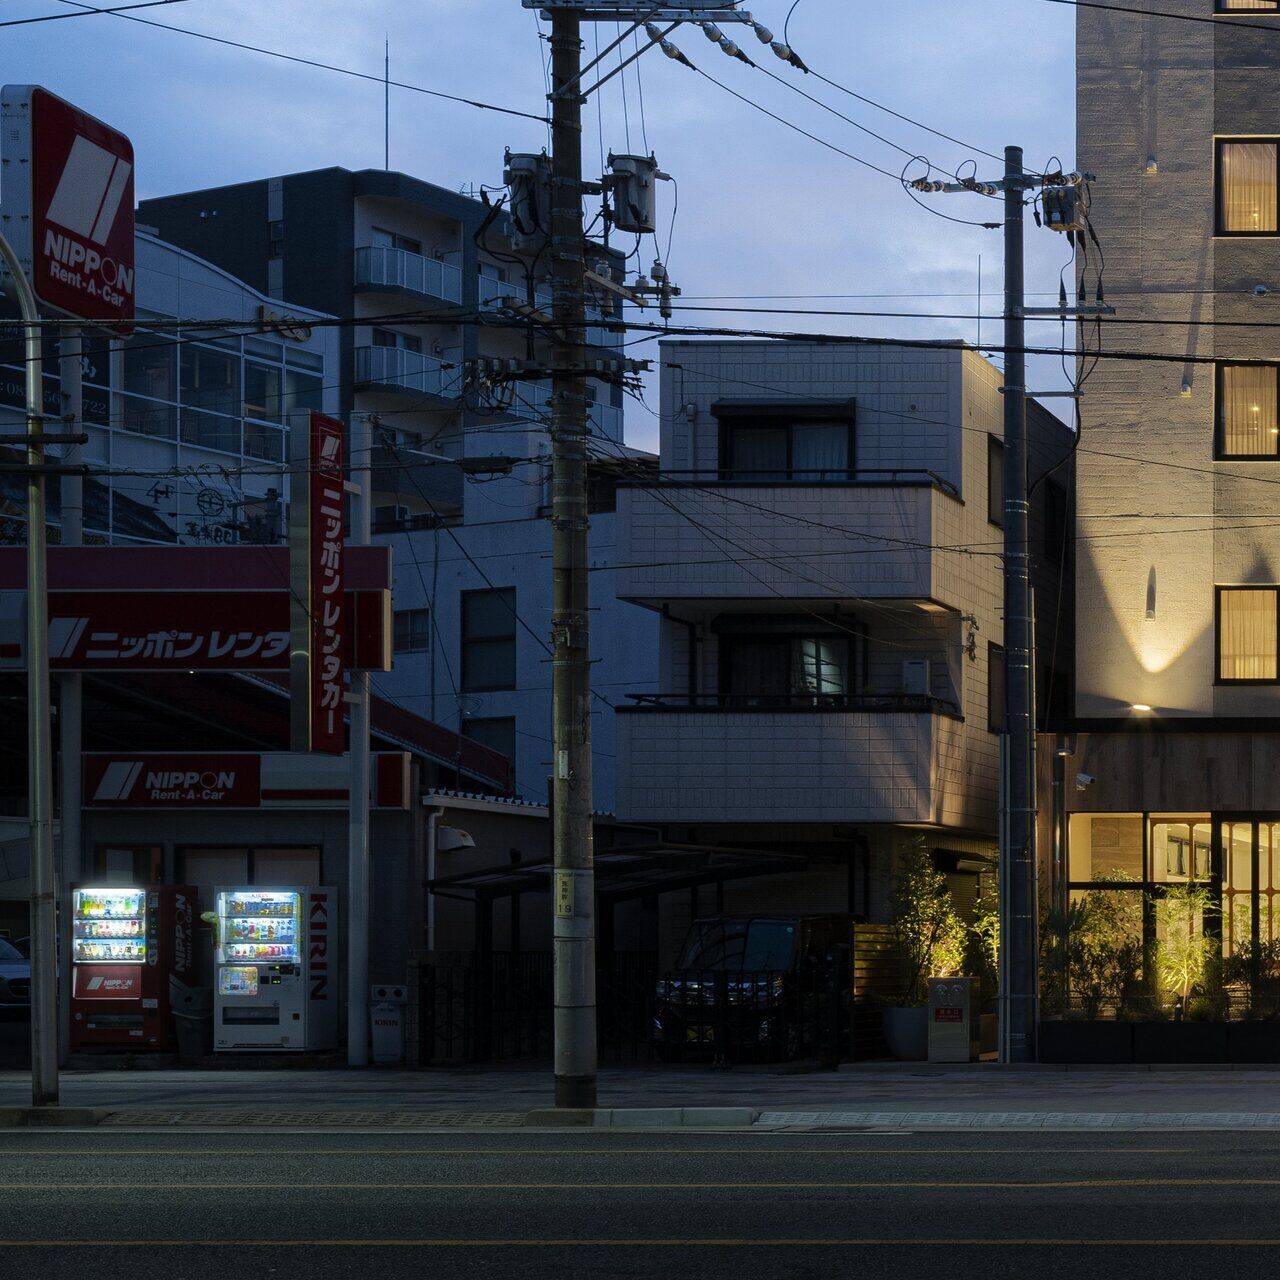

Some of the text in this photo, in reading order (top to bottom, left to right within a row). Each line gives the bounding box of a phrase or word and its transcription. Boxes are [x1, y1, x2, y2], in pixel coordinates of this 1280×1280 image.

[44, 229, 134, 294] NIPPON
[51, 261, 124, 307] Rent-A-Car
[320, 488, 342, 734] ニッポンレンタカー
[85, 629, 289, 660] ニッポンレンタ
[145, 771, 236, 789] NIPPON
[151, 789, 225, 800] Rent-A-Car
[175, 893, 187, 975] NIPPON
[310, 893, 328, 1001] KIRIN
